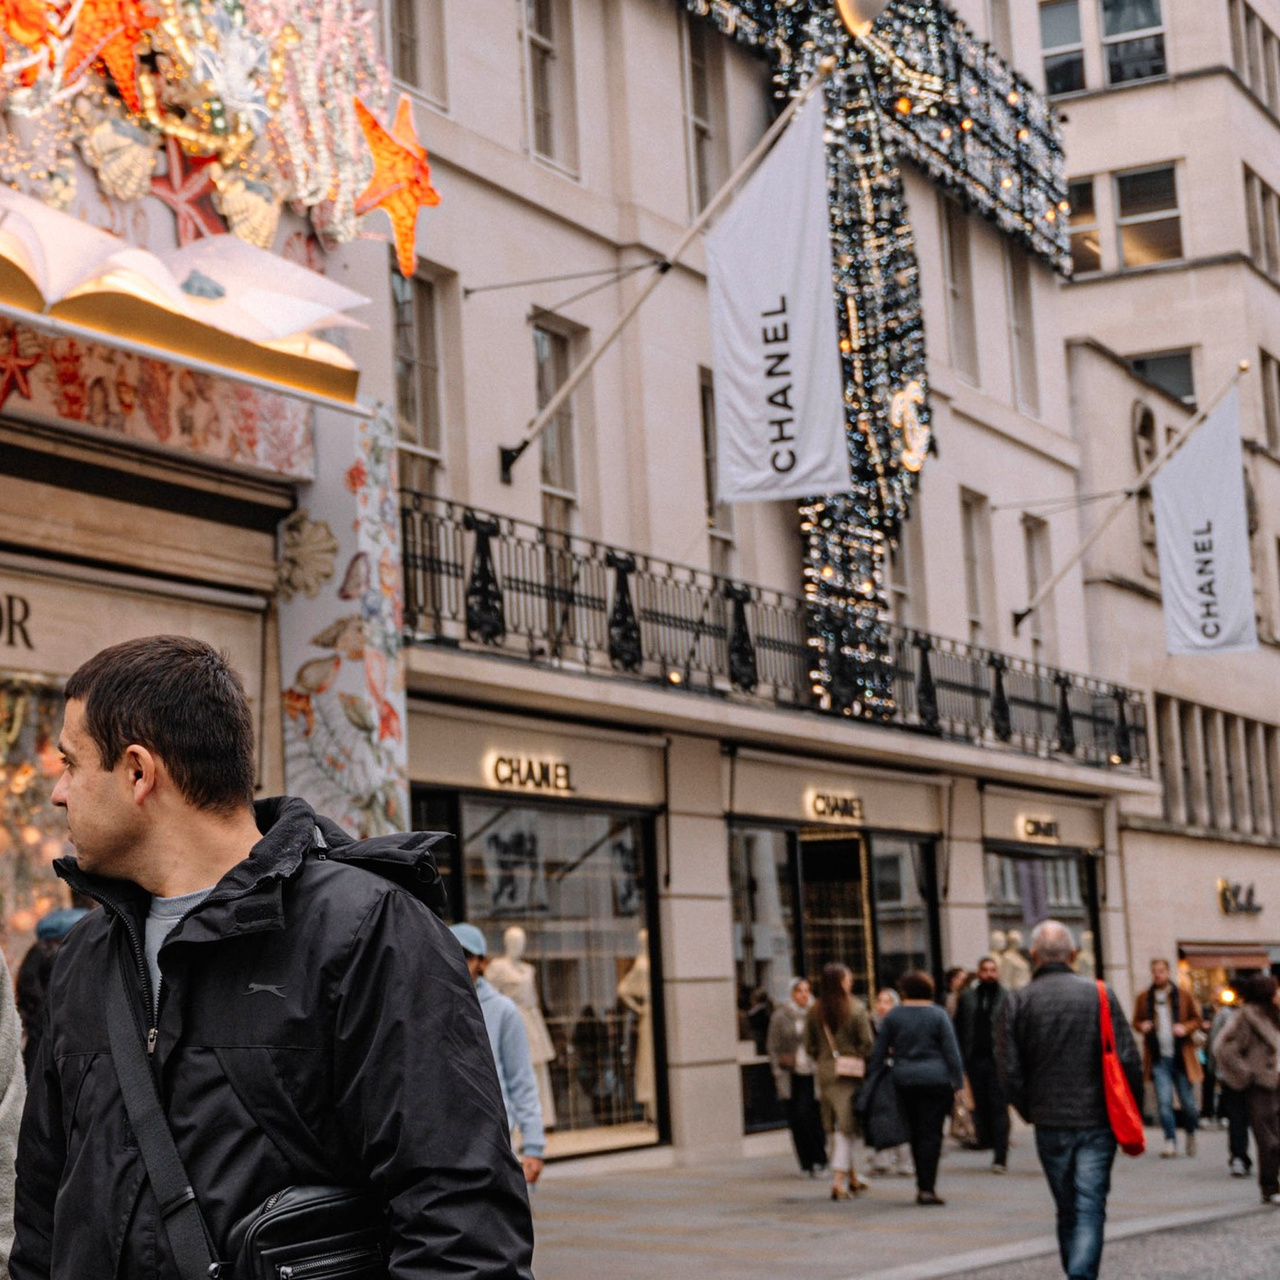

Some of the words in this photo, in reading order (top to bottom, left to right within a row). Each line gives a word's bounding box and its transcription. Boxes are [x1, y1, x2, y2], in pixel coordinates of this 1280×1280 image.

[761, 294, 797, 475] CHANEL
[1193, 519, 1221, 639] CHANEL
[494, 757, 576, 792] CHANEL
